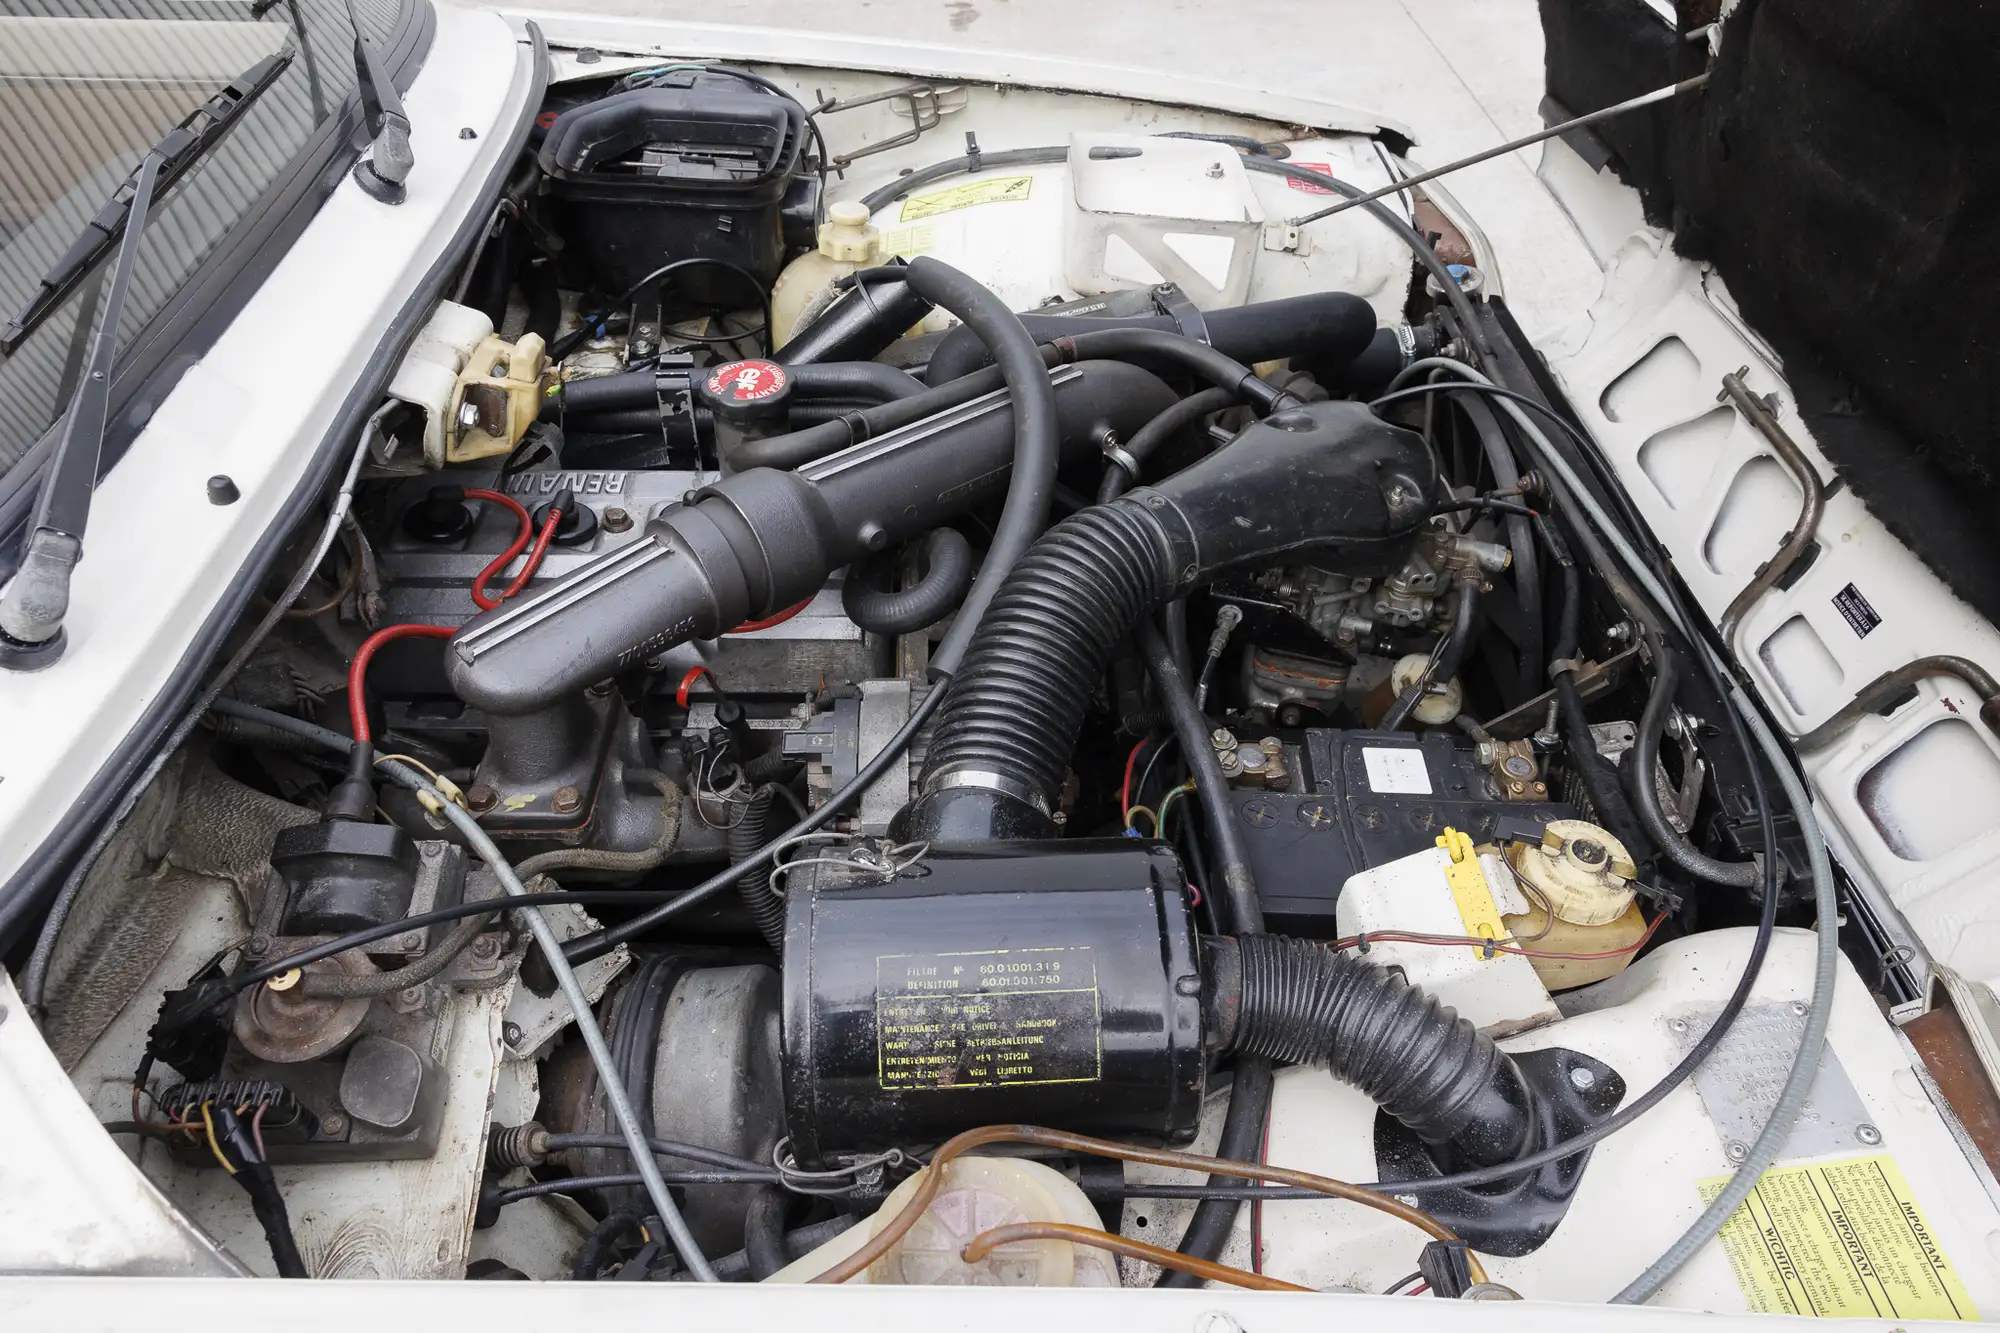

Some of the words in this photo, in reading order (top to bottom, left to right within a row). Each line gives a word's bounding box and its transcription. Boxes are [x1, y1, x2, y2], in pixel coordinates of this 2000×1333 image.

[1832, 597, 1846, 612] NOTICE
[1844, 599, 1863, 622] REPORTER
[1862, 622, 1869, 630] LA
[963, 1005, 990, 1014] NOTICE
[997, 1066, 1032, 1075] LIBRETTO
[1788, 1180, 1808, 1213] running.
[1834, 1166, 1849, 1185] avoir
[1845, 1186, 1855, 1197] au
[1852, 1163, 1865, 1177] que
[1862, 1178, 1872, 1186] le
[1867, 1187, 1887, 1215] moteur
[1883, 1217, 1902, 1246] tourne.
[1729, 1212, 1752, 1256] bklemmen.
[1765, 1175, 1782, 1202] having
[1780, 1206, 1815, 1262] disconnected
[1810, 1267, 1821, 1281] the
[1819, 1284, 1831, 1302] two
[1775, 1174, 1791, 1197] Never
[1788, 1199, 1808, 1231] connect
[1807, 1239, 1827, 1272] charger
[1825, 1273, 1845, 1307] without
[1795, 1171, 1810, 1194] Never
[1806, 1195, 1832, 1238] disconnect
[1829, 1240, 1848, 1270] battery
[1846, 1272, 1862, 1295] while
[1831, 1210, 1873, 1277] IMPORTANT
[1844, 1164, 1855, 1176] Ne
[1871, 1217, 1891, 1243] jamais
[1888, 1246, 1898, 1258] un
[1896, 1260, 1921, 1299] chargeur
[1849, 1198, 1876, 1234] préalable
[1864, 1161, 1875, 1173] Ne
[1895, 1222, 1916, 1249] jamais
[1913, 1252, 1924, 1260] la
[1919, 1262, 1941, 1296] batterie
[1901, 1202, 1946, 1269] IMPORTANT
[1742, 1217, 1752, 1230] die
[1749, 1232, 1769, 1266] batterie
[1766, 1269, 1779, 1284] bei
[1765, 1227, 1794, 1279] WICHTIG
[1776, 1218, 1784, 1227] to
[1781, 1229, 1792, 1242] the
[1789, 1244, 1807, 1274] battery
[1804, 1277, 1829, 1316] terminal.
[1849, 1215, 1862, 1231] aux
[1857, 1231, 1877, 1261] bornes
[1874, 1262, 1884, 1274] de
[1880, 1275, 1890, 1284] la
[1871, 1236, 1905, 1284] déconnecté
